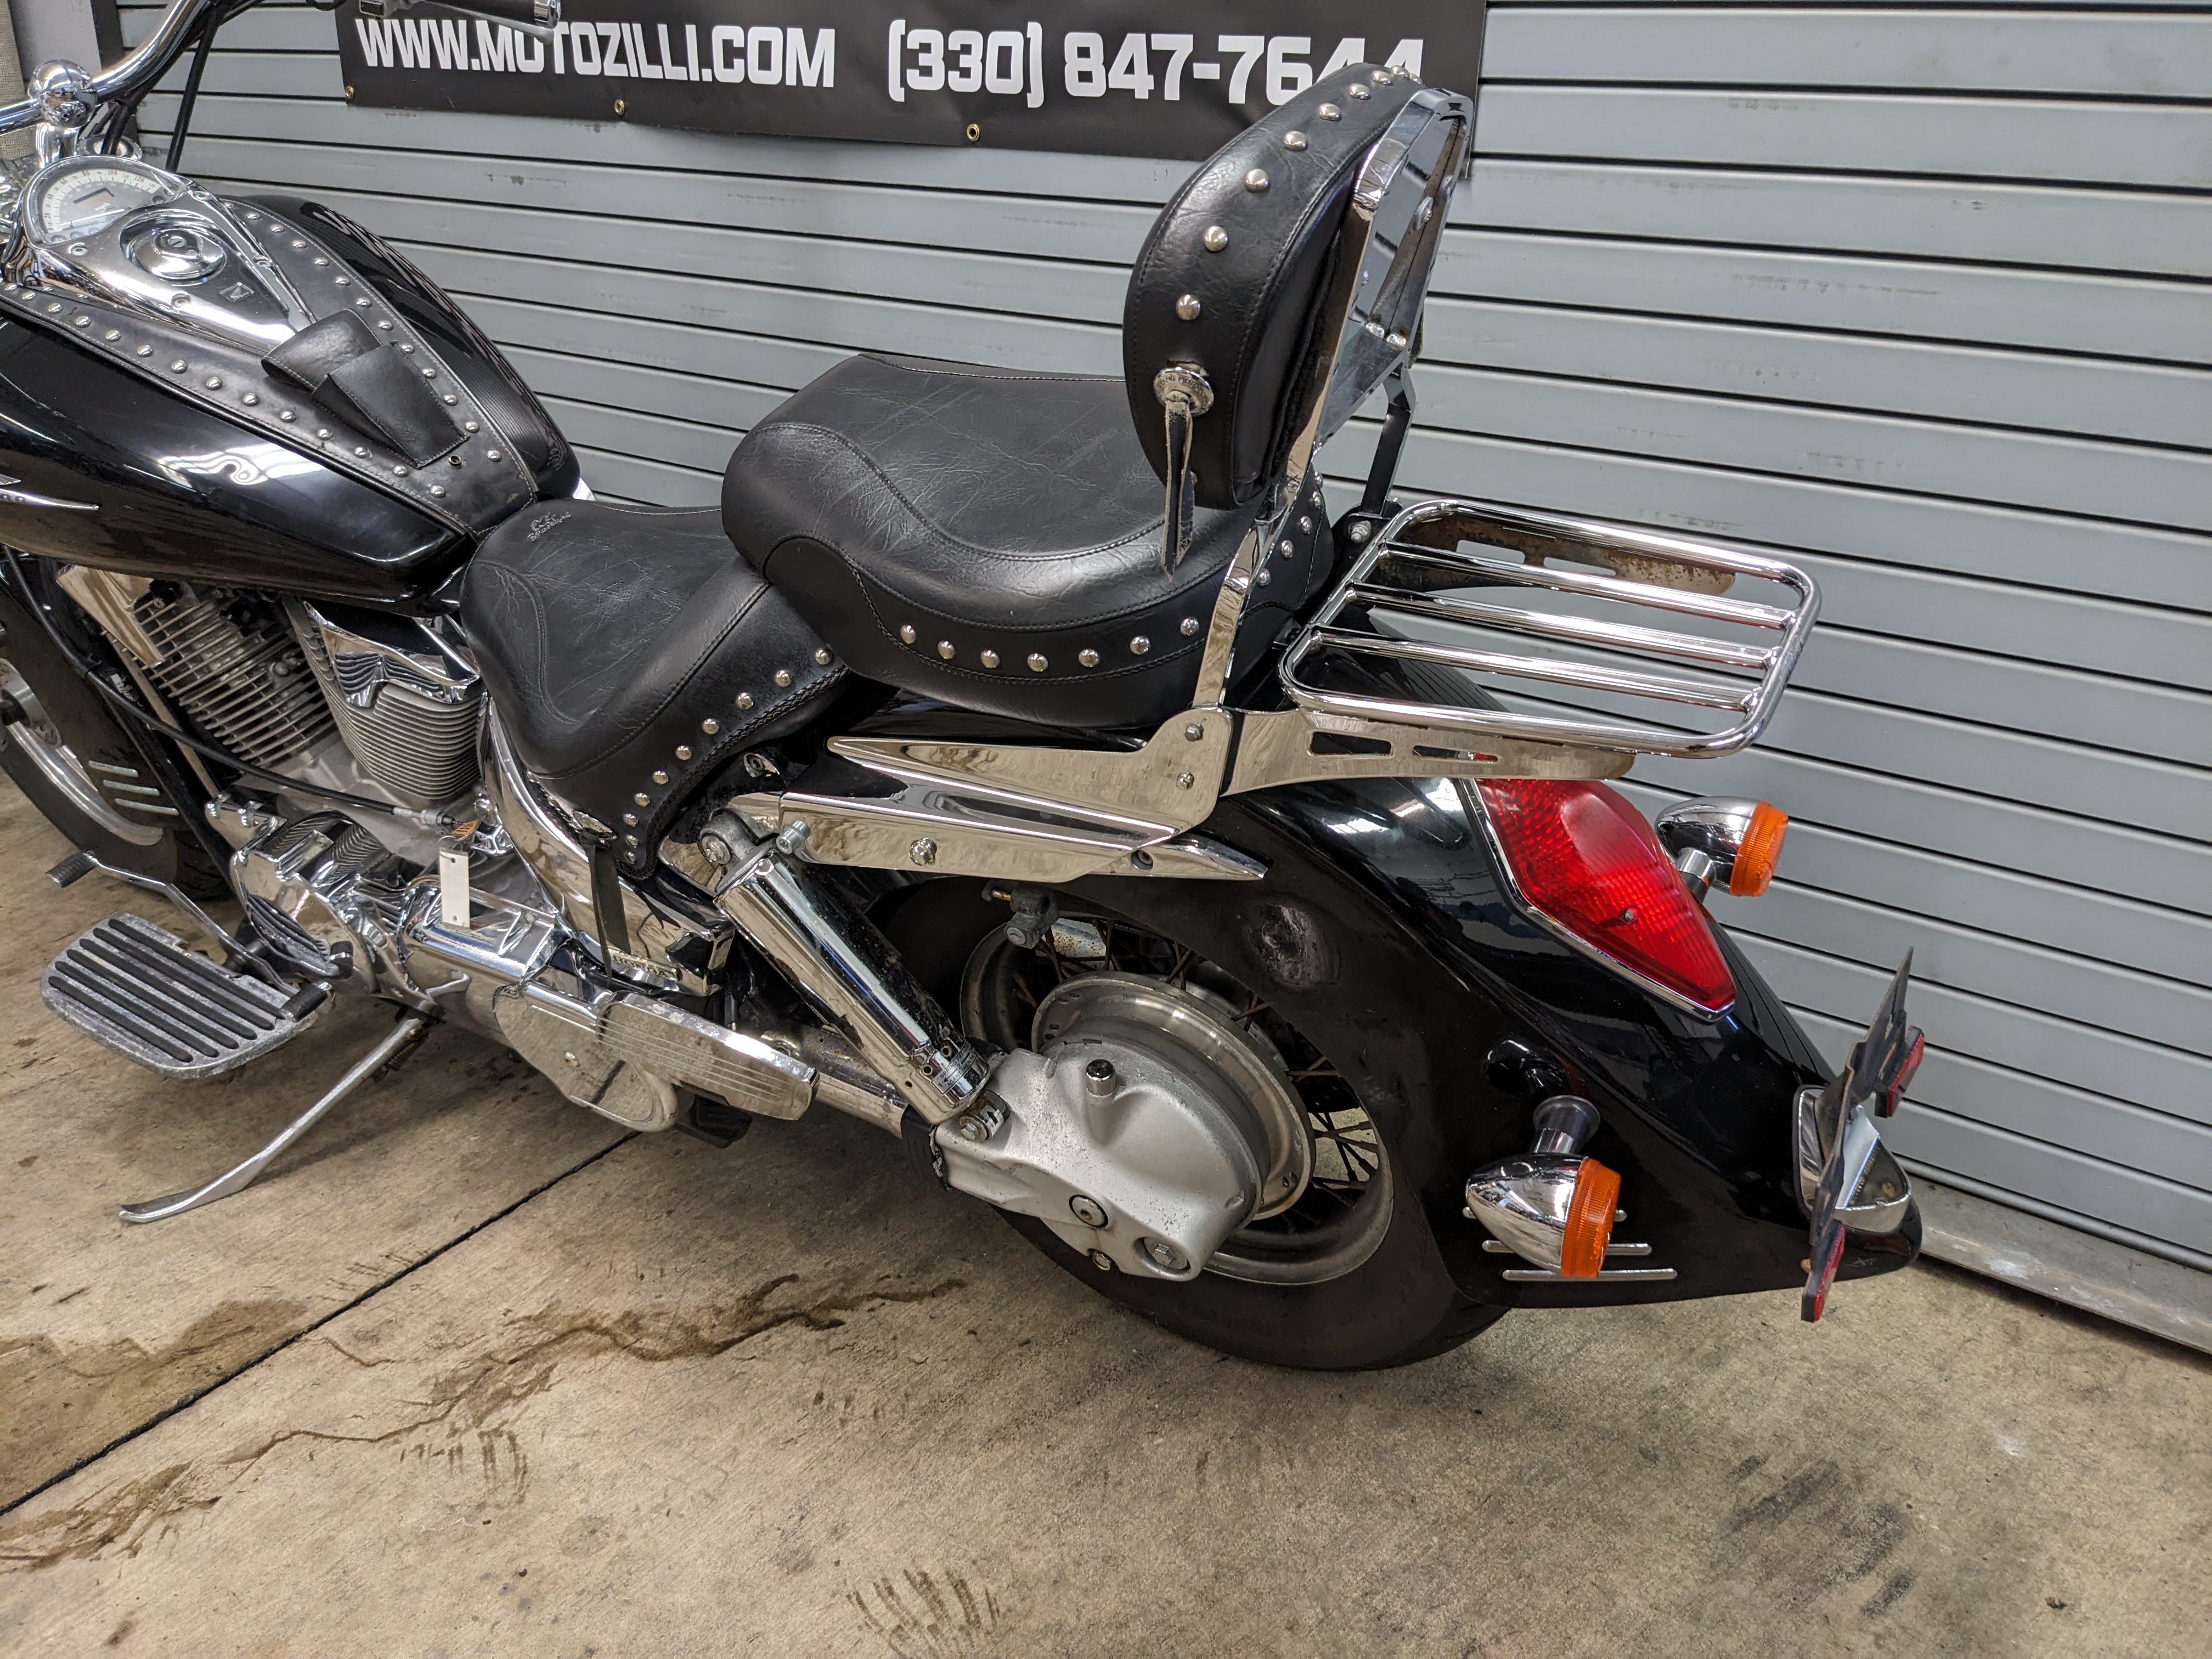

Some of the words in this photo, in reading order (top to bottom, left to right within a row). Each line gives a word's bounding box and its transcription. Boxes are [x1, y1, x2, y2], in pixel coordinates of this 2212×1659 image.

[355, 19, 836, 88] WWW.MOTOZILLI.COM
[888, 19, 1045, 108] (330)
[95, 202, 110, 211] mph
[940, 1061, 957, 1078] SPRING
[947, 1071, 962, 1086] ADJUST
